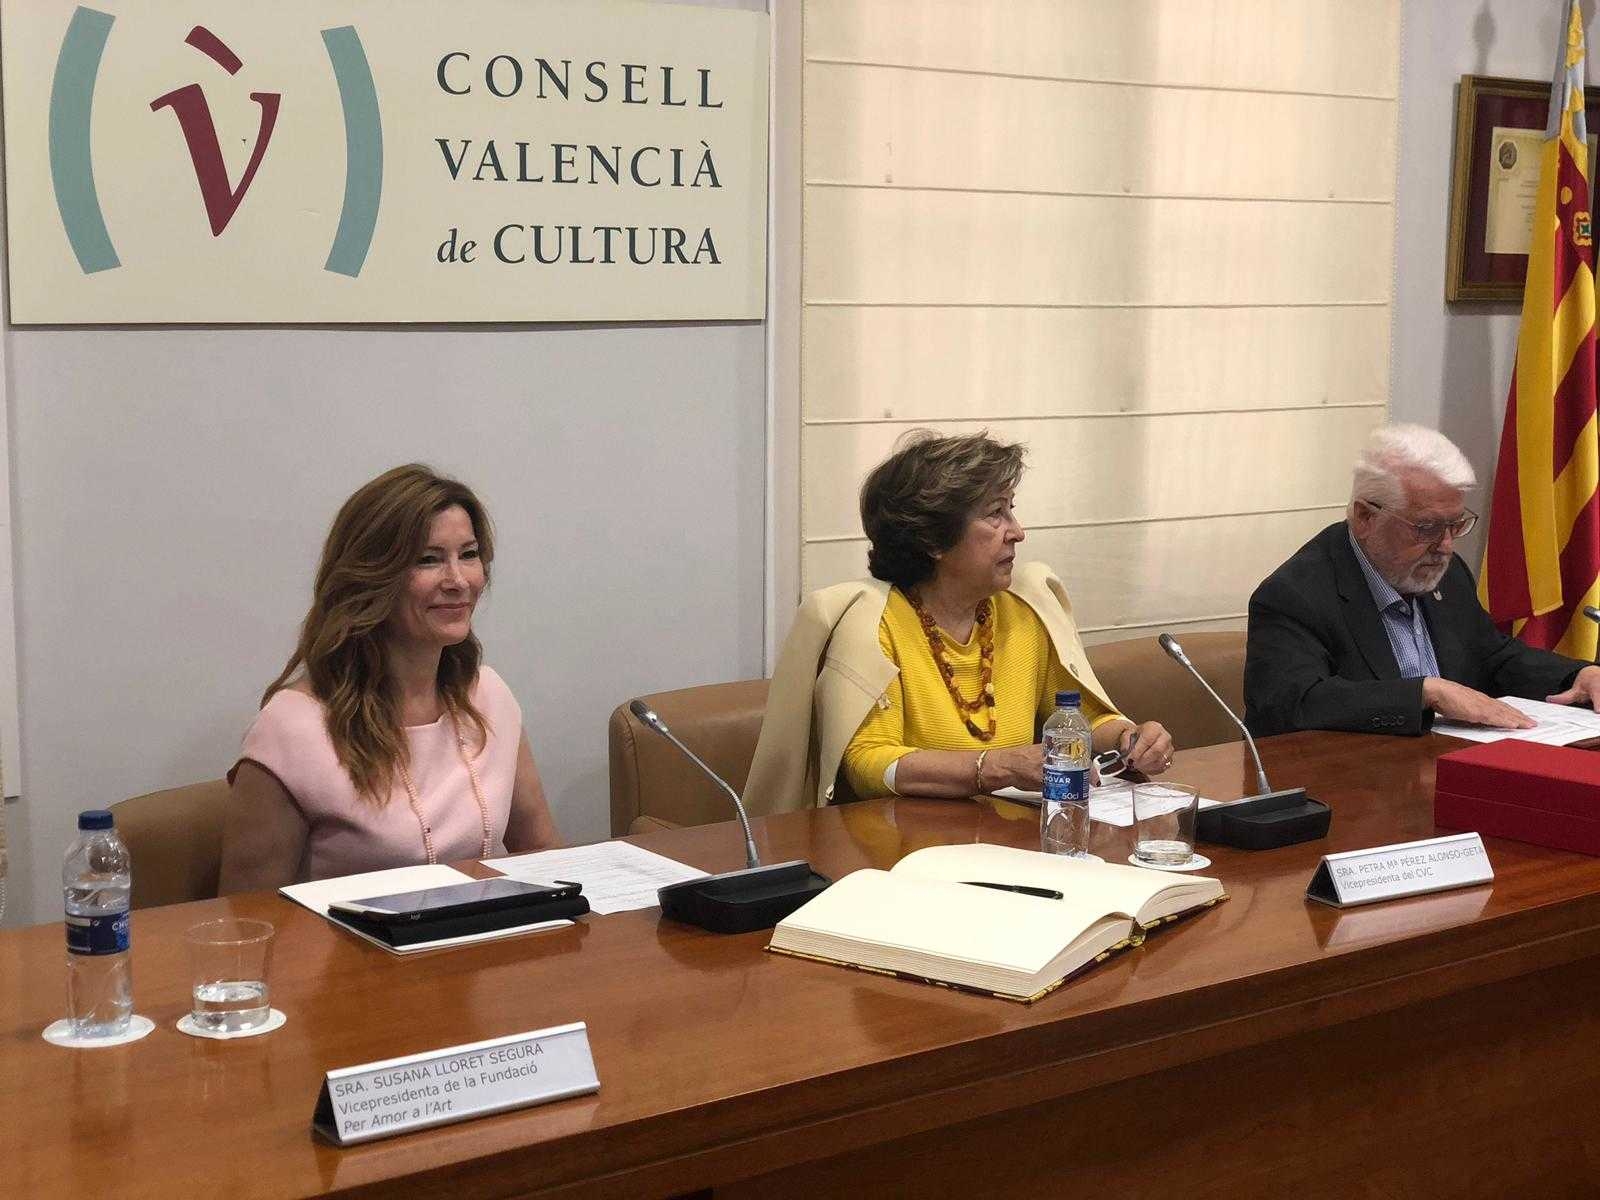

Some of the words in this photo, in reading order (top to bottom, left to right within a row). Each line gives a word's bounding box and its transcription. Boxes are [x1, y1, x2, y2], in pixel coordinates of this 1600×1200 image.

[437, 52, 723, 108] CONSELL
[435, 138, 722, 187] VALENCIÀ
[437, 228, 477, 263] de
[493, 224, 721, 264] CULTURA
[1340, 873, 1401, 889] Vicepresidenta
[1359, 861, 1386, 873] PETRA
[335, 1081, 368, 1098] SRA.
[373, 1067, 432, 1090] SUSANA
[435, 1055, 484, 1077] LLORET
[489, 1043, 544, 1065] SEGURA
[338, 1084, 440, 1115] Vicepresidenta
[444, 1080, 460, 1093] de
[464, 1076, 476, 1088] la
[480, 1060, 538, 1085] Fundació
[343, 1119, 367, 1133] Per
[371, 1109, 408, 1128] Amor
[412, 1107, 420, 1119] a
